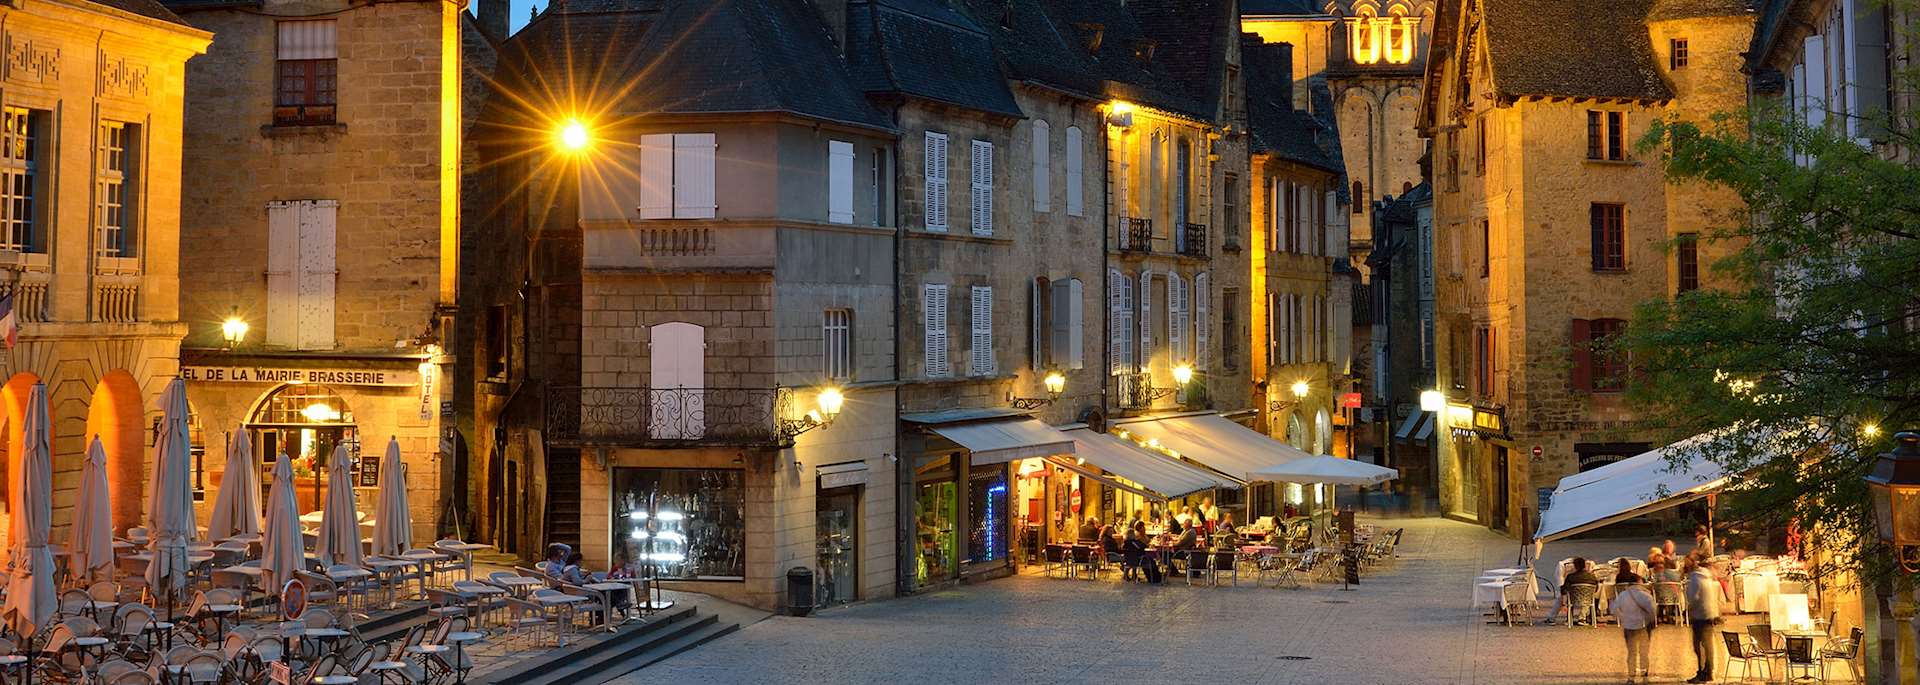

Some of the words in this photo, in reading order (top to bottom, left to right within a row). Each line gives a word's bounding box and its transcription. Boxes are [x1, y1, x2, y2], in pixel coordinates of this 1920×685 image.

[206, 369, 224, 380] DE
[231, 369, 248, 380] LA
[256, 370, 301, 381] MAIRIE
[309, 371, 385, 384] BRASSERIE
